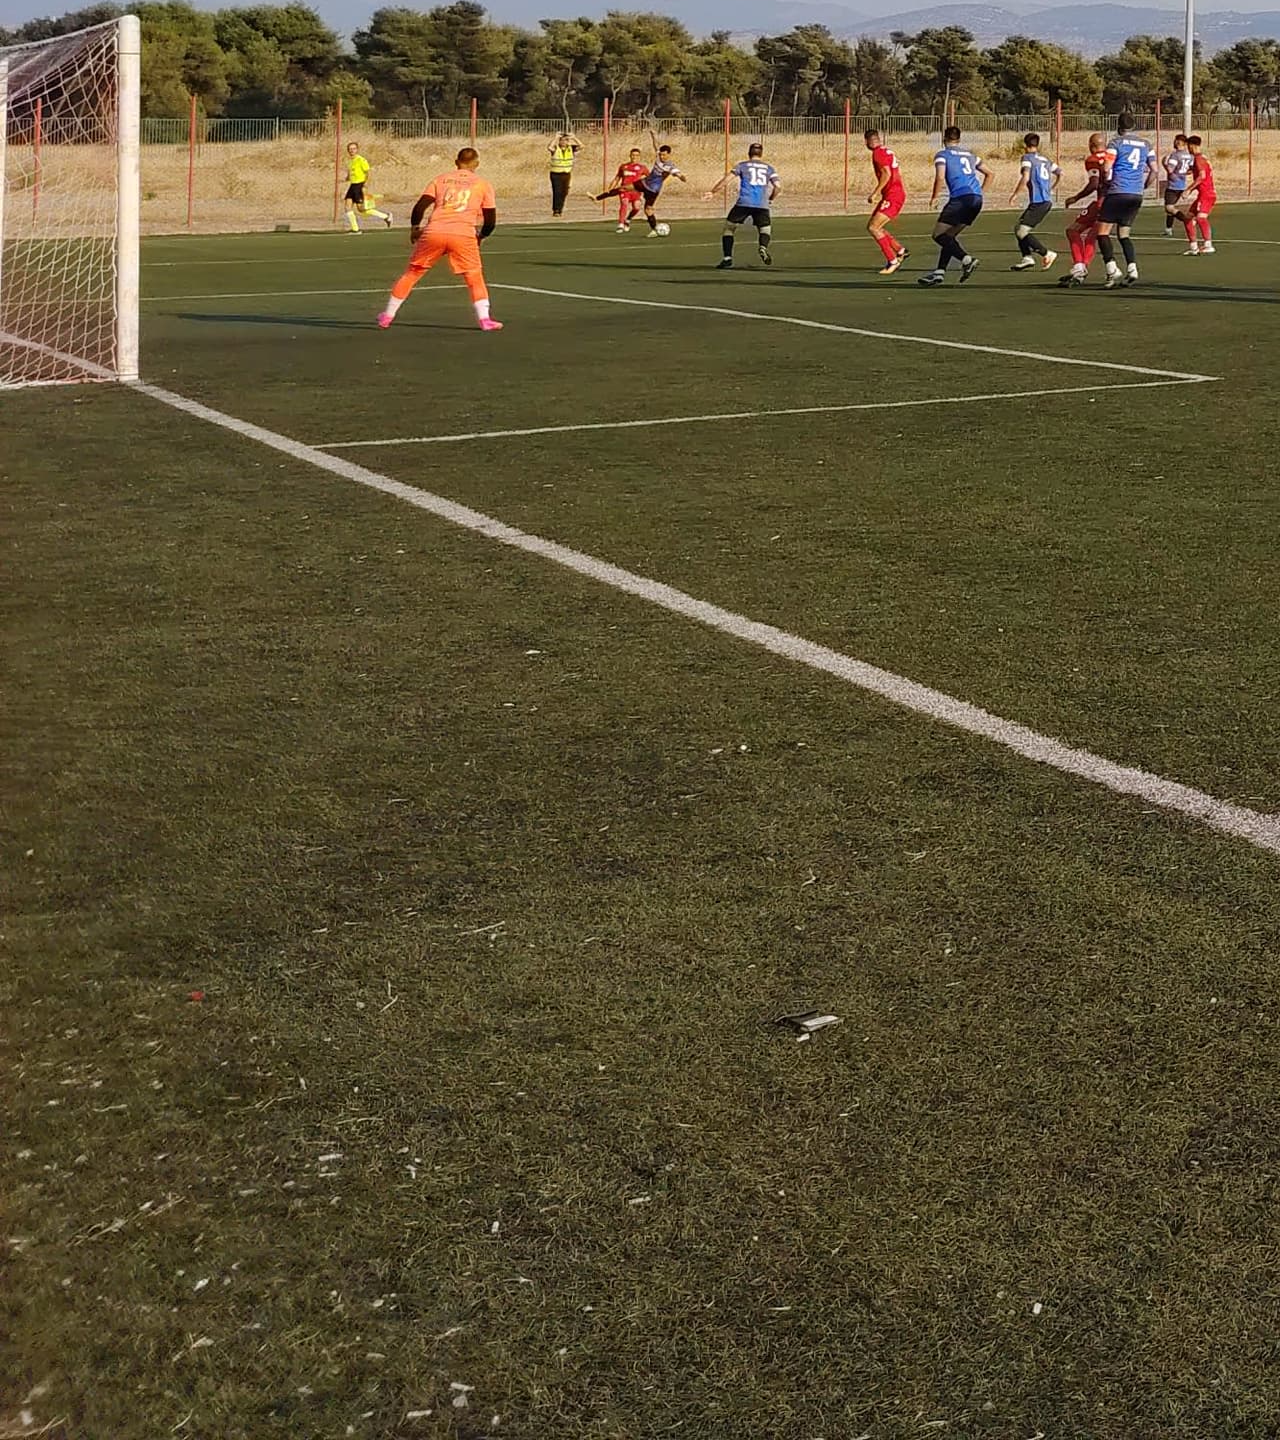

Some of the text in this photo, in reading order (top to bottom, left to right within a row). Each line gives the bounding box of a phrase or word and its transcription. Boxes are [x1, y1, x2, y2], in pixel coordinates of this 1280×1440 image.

[960, 157, 972, 174] 3
[1128, 148, 1140, 170] 4
[749, 167, 768, 185] 15
[1040, 162, 1049, 179] 6
